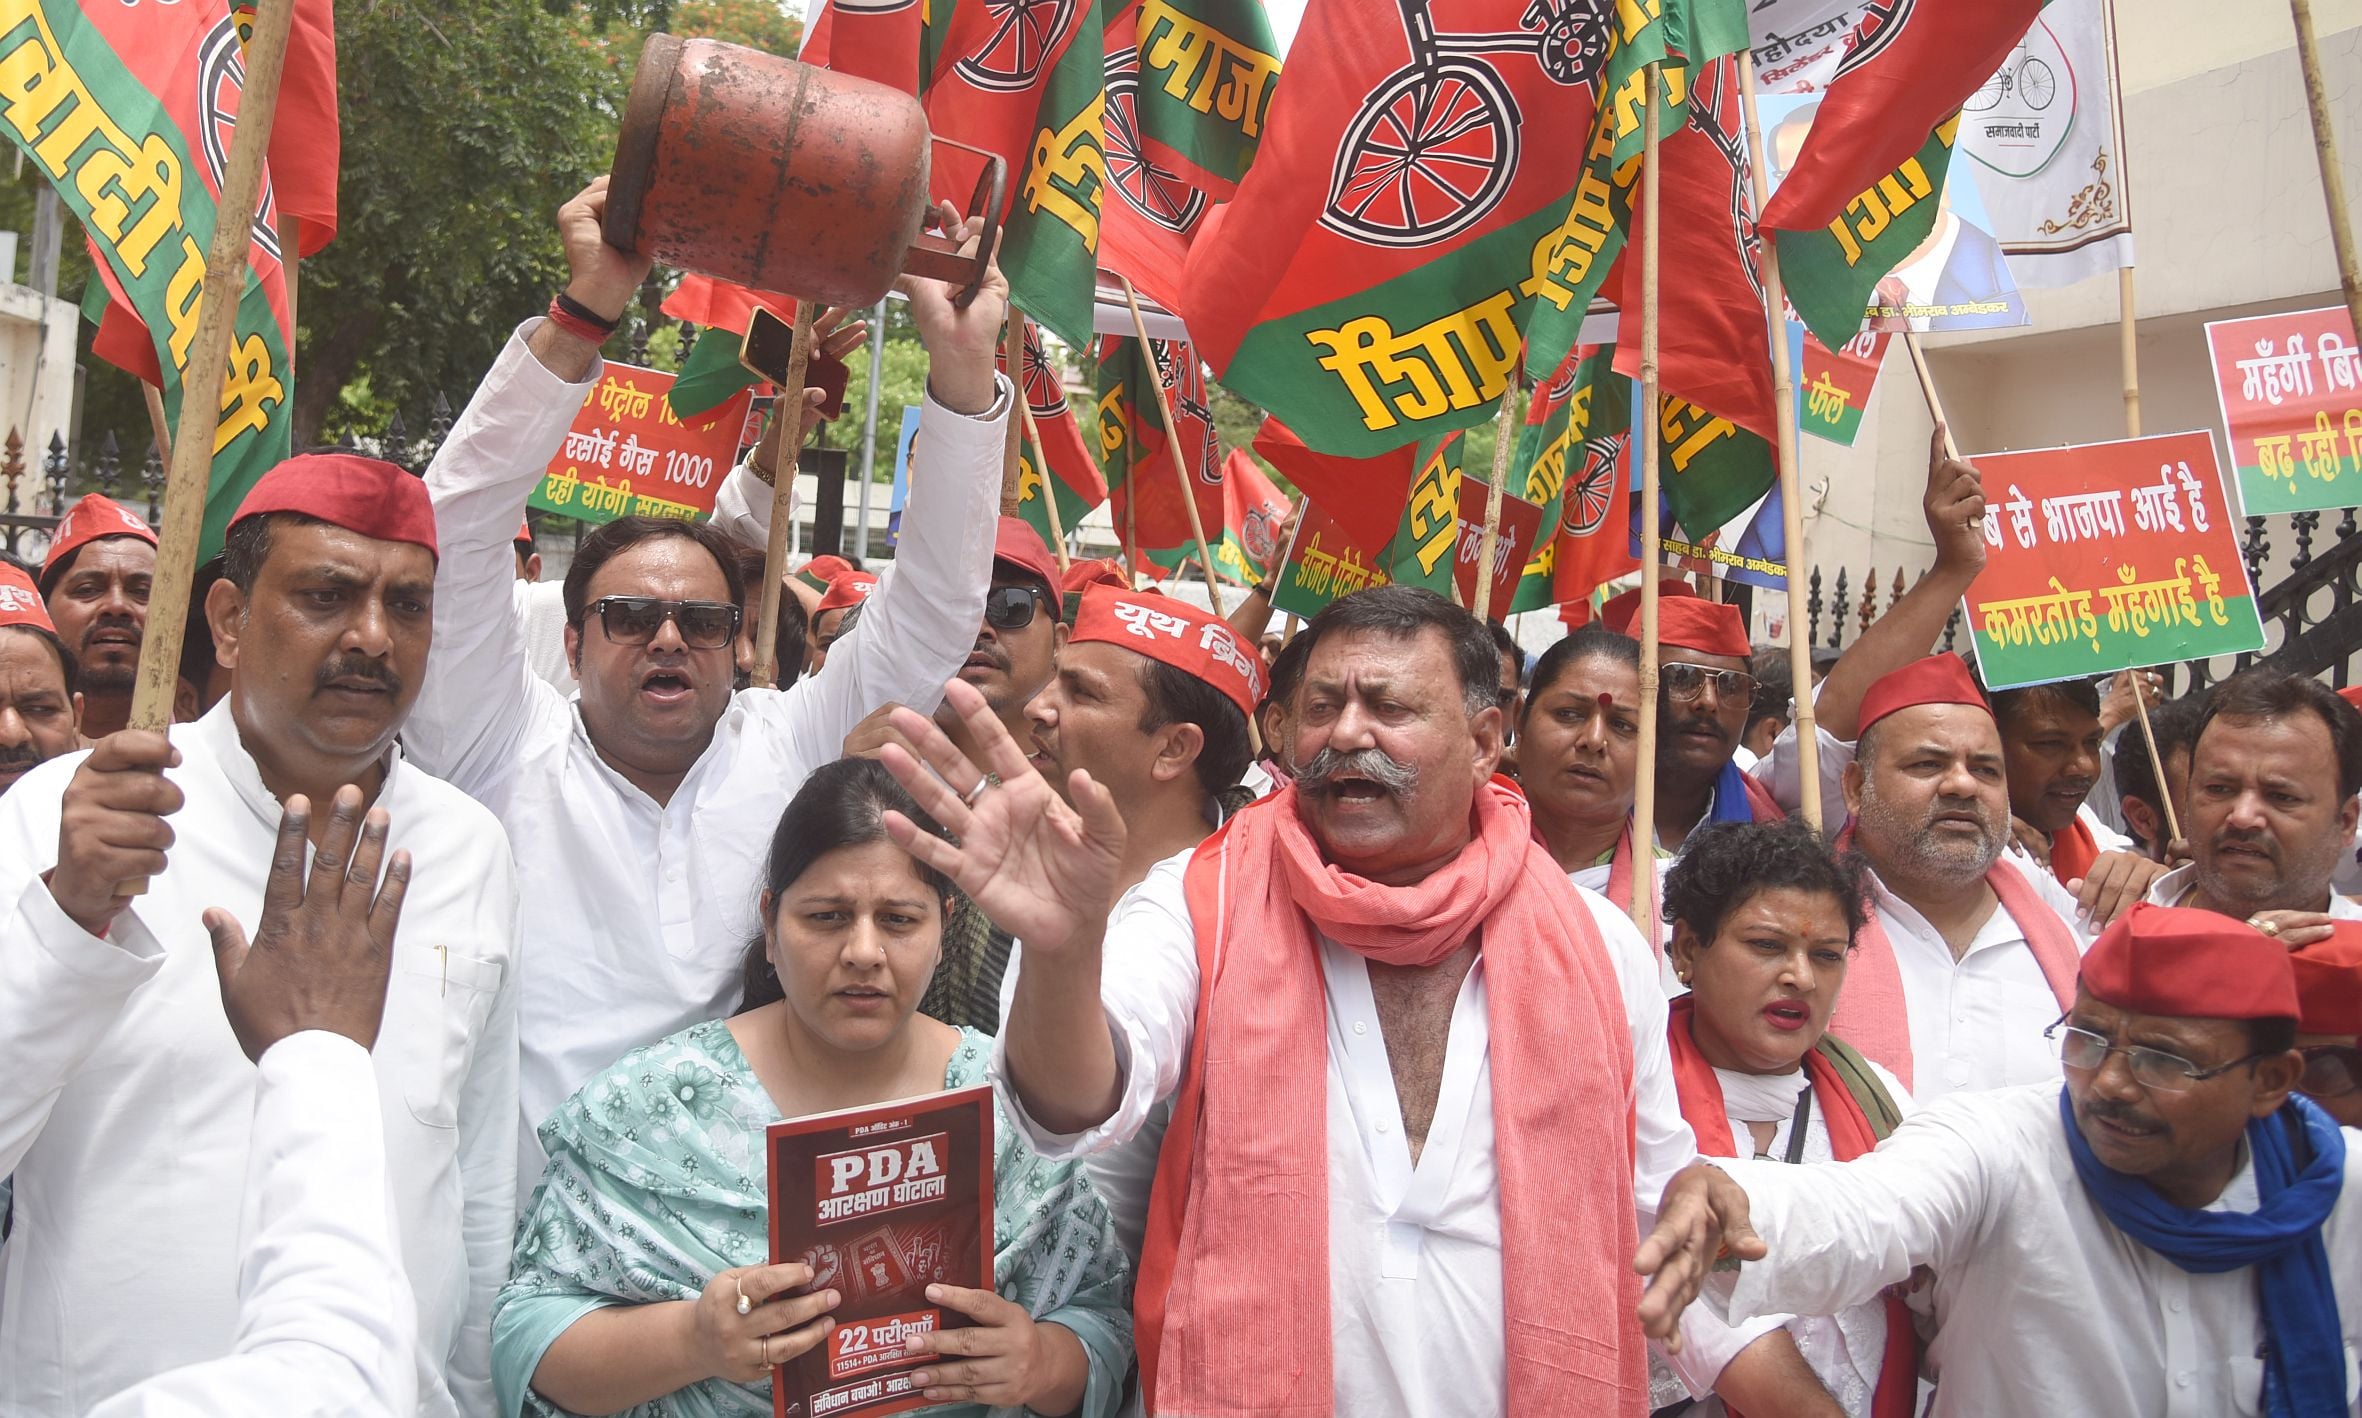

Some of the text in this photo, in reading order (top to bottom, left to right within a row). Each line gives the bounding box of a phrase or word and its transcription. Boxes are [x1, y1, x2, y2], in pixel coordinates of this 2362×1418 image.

[1984, 122, 2040, 138] समाजवादी पार्टी
[1902, 302, 1948, 318] भीमराव
[600, 376, 653, 423] पेट्रोल
[1808, 371, 1851, 424] फेल
[565, 428, 713, 488] रसोई गैस 1000
[2253, 434, 2297, 495] बढ़
[2296, 410, 2342, 483] रही
[546, 466, 580, 506] रही
[581, 476, 633, 517] योगी
[1982, 461, 2210, 551] ब से भाजपा आई है
[1296, 531, 1337, 596] डीजल
[1708, 547, 1744, 568] भीमराव
[1113, 600, 1190, 640] यूथ
[1979, 554, 2230, 655] कमरतोड़ महँगाई है
[855, 1126, 869, 1135] PDA
[831, 1140, 939, 1194] PDA
[818, 1175, 947, 1219] आरक्षण घोटाला
[839, 1325, 869, 1355] 22
[863, 1354, 878, 1365] PDA
[814, 1390, 849, 1414] संविधान
[886, 1377, 912, 1393] आरक्ष
